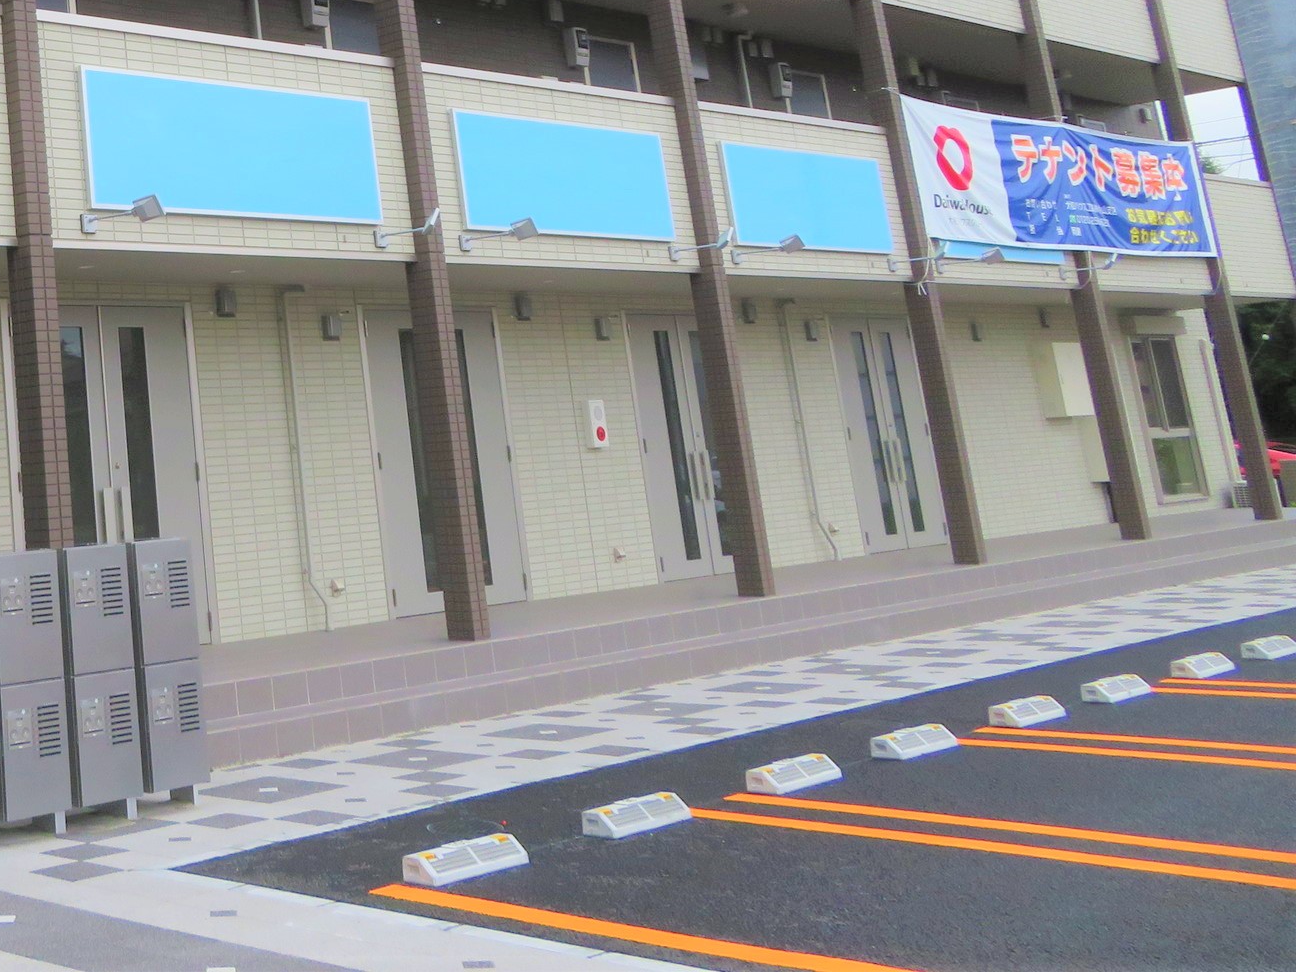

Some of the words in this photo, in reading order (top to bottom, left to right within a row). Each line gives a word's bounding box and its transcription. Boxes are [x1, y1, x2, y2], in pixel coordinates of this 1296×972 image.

[1010, 133, 1188, 201] テナント募集中
